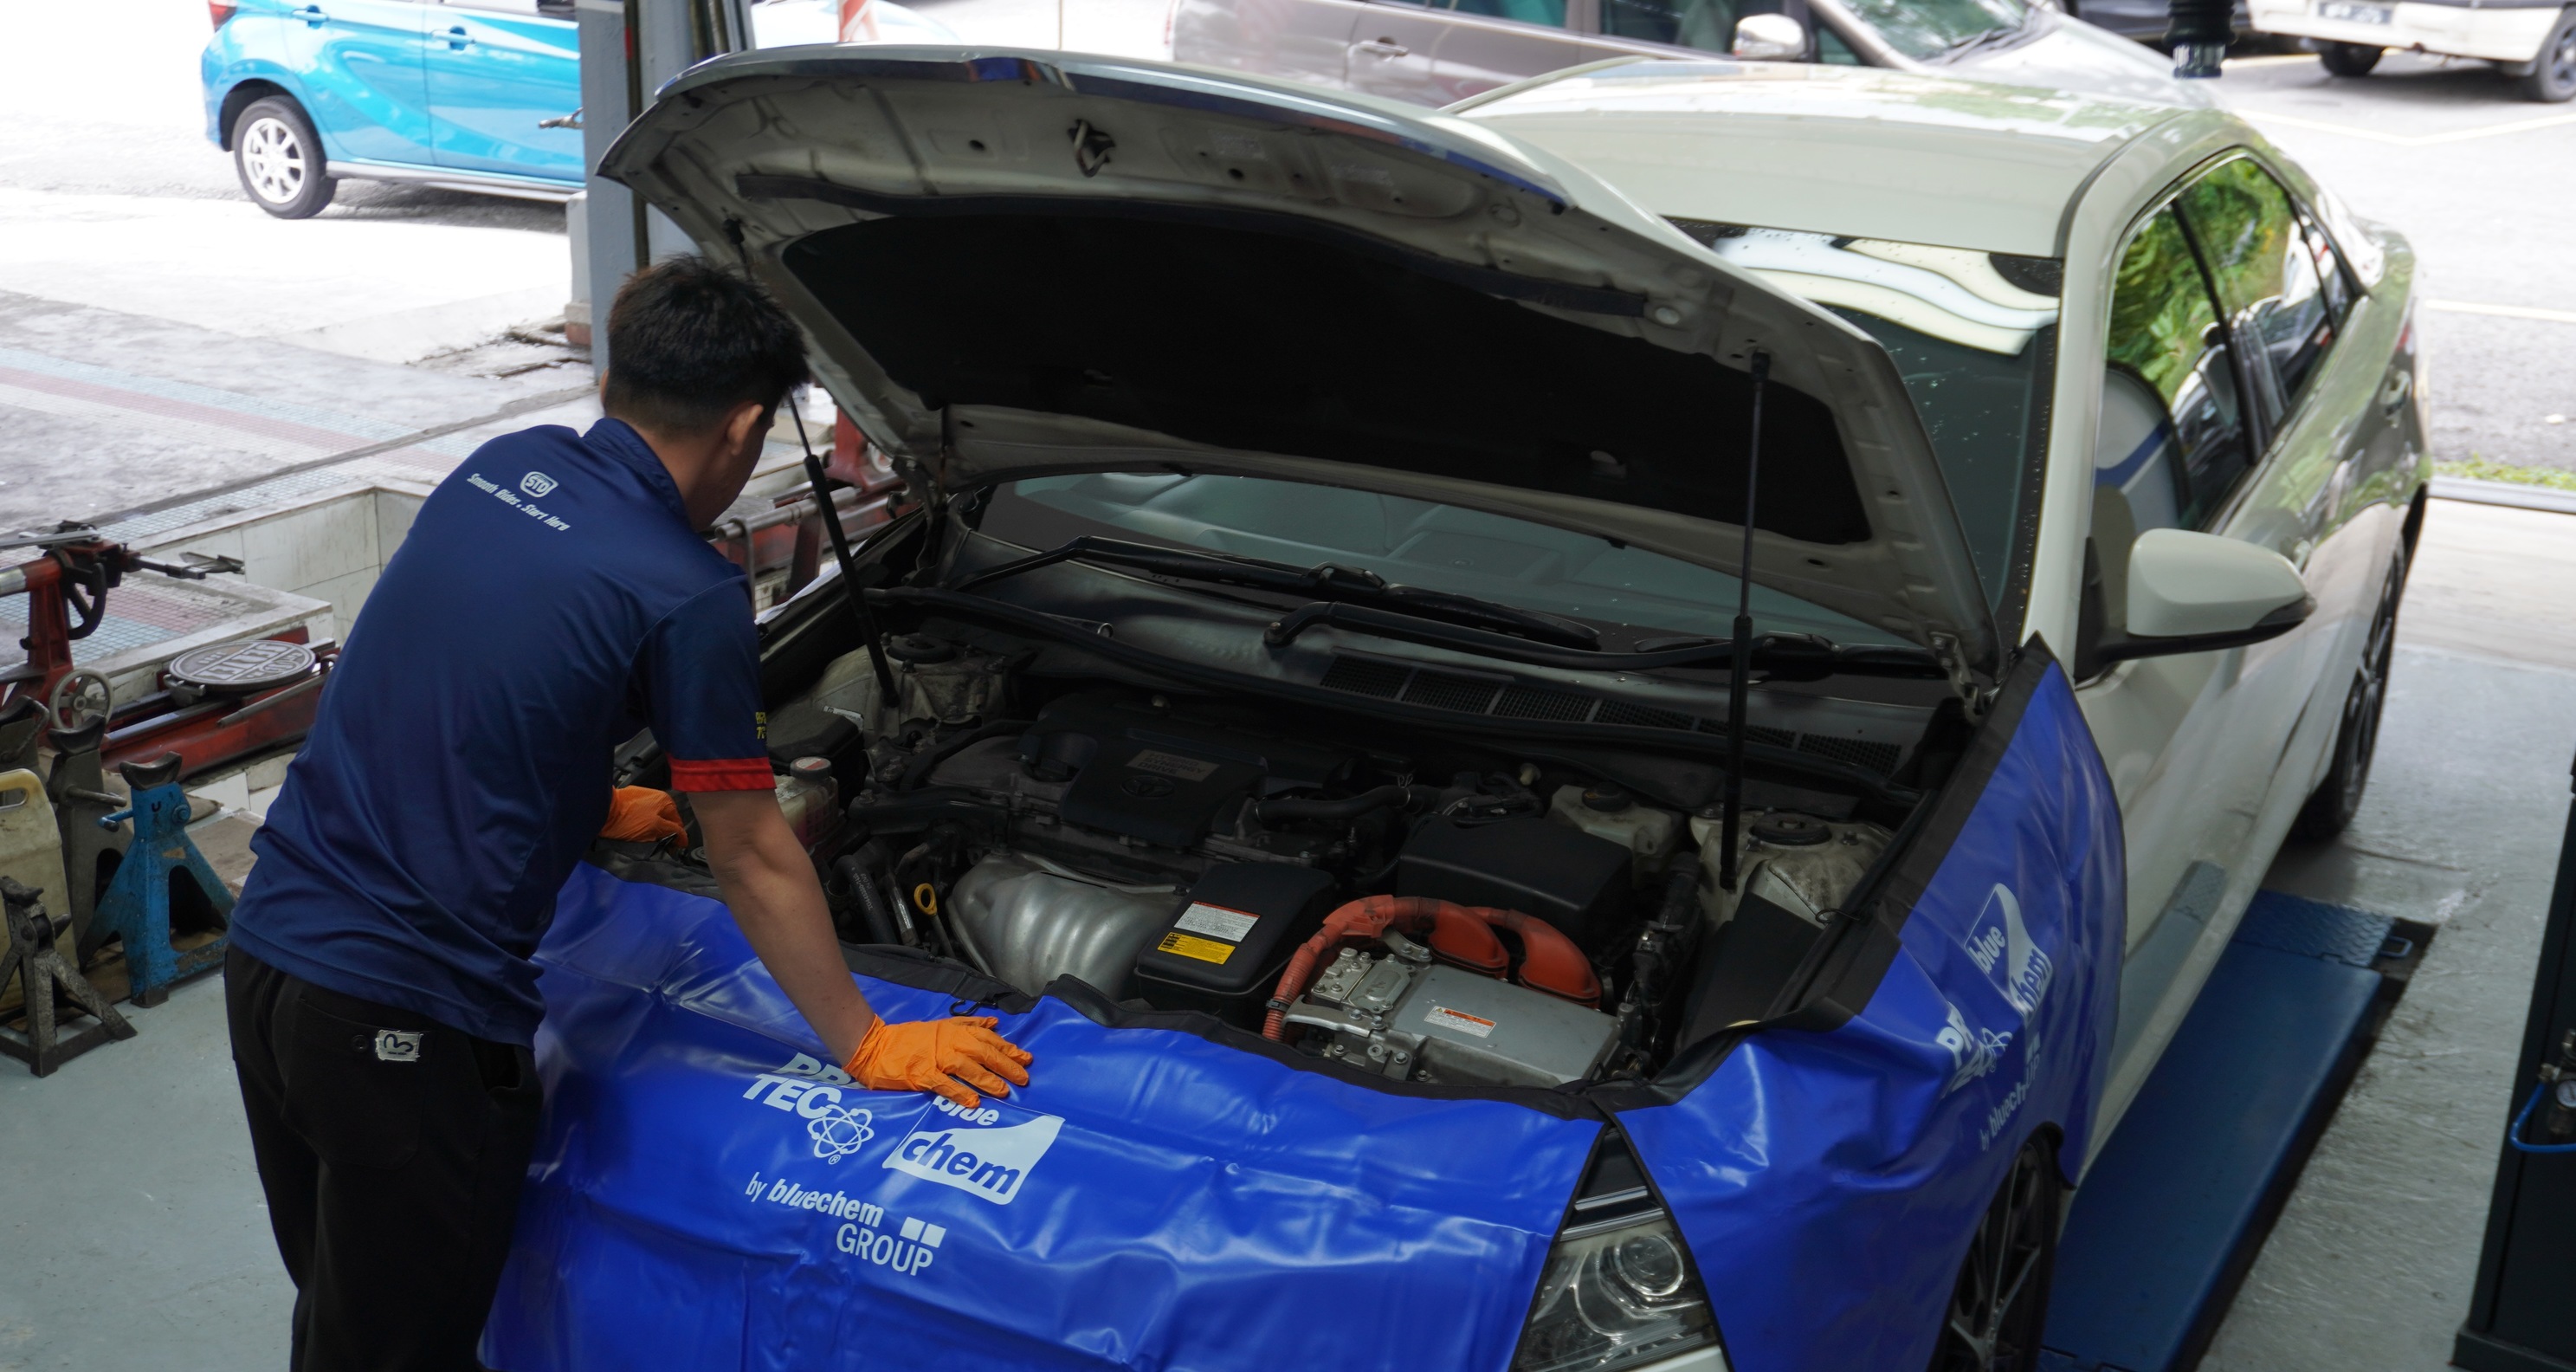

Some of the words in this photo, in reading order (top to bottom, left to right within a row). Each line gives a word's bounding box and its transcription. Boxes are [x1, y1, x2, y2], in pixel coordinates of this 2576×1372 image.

[467, 473, 500, 494] Smooth
[494, 489, 521, 506] Rides
[520, 503, 549, 521] Start
[544, 515, 571, 531] Here
[1968, 926, 2006, 974] blue
[1936, 1001, 1974, 1071] PR
[742, 1073, 843, 1119] TEC
[772, 1052, 869, 1090] PR
[1989, 1082, 2027, 1139] bluech
[901, 1133, 1020, 1195] chem
[745, 1171, 768, 1202] by
[767, 1178, 885, 1228] bluechem
[836, 1223, 934, 1277] GROUP
